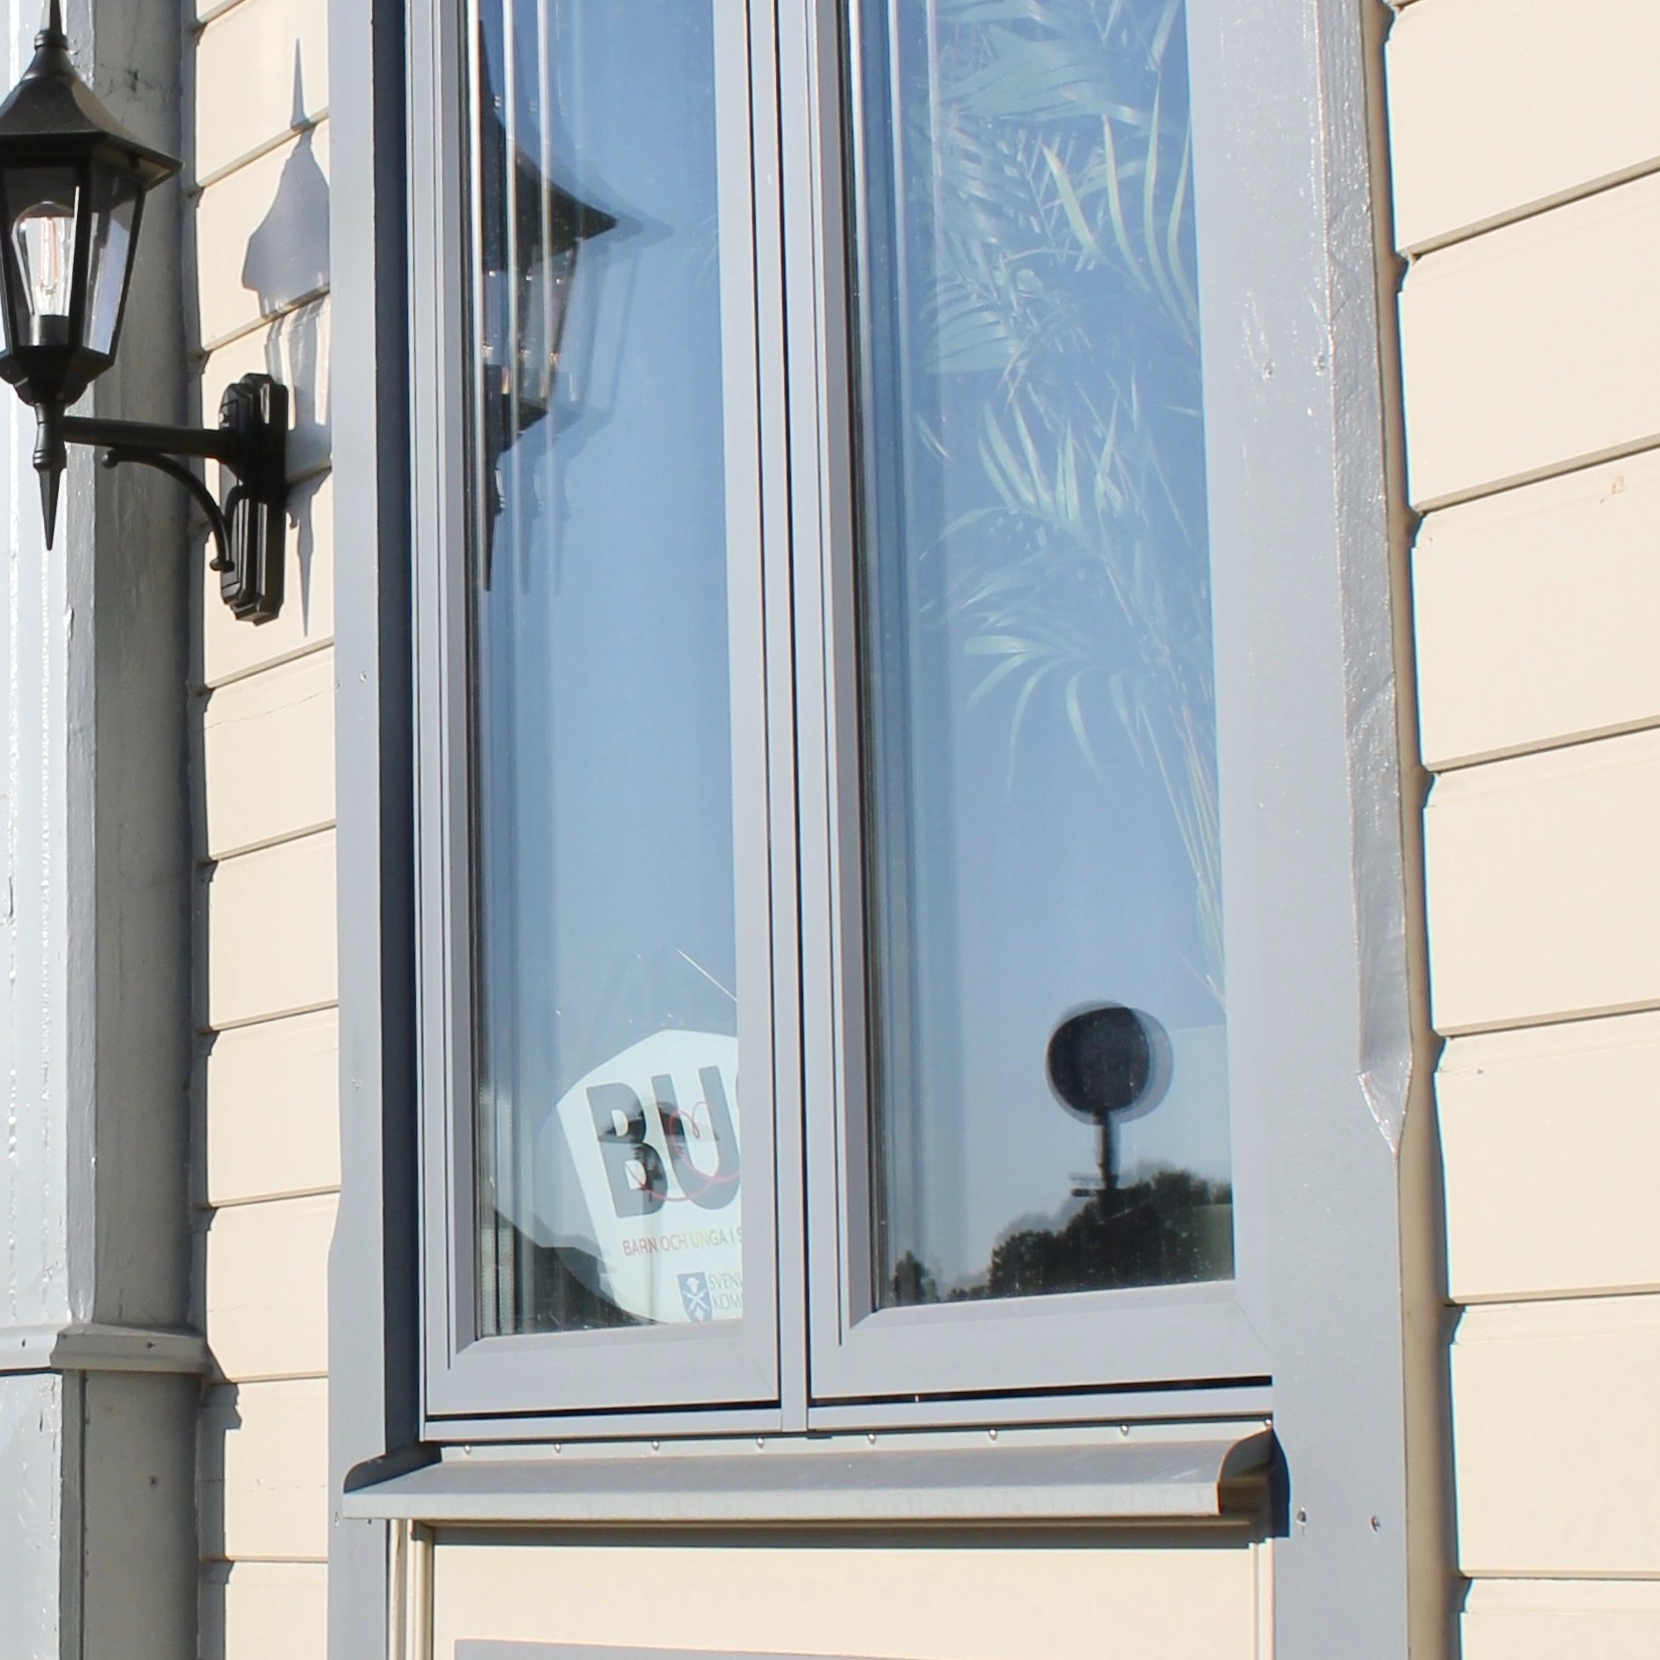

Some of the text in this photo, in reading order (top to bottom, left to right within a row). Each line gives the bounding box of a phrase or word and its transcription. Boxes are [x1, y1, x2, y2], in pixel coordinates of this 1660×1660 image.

[586, 1065, 740, 1219] BU
[622, 1237, 658, 1256] BARN
[660, 1234, 688, 1252] OCH
[691, 1228, 728, 1249] UNGA
